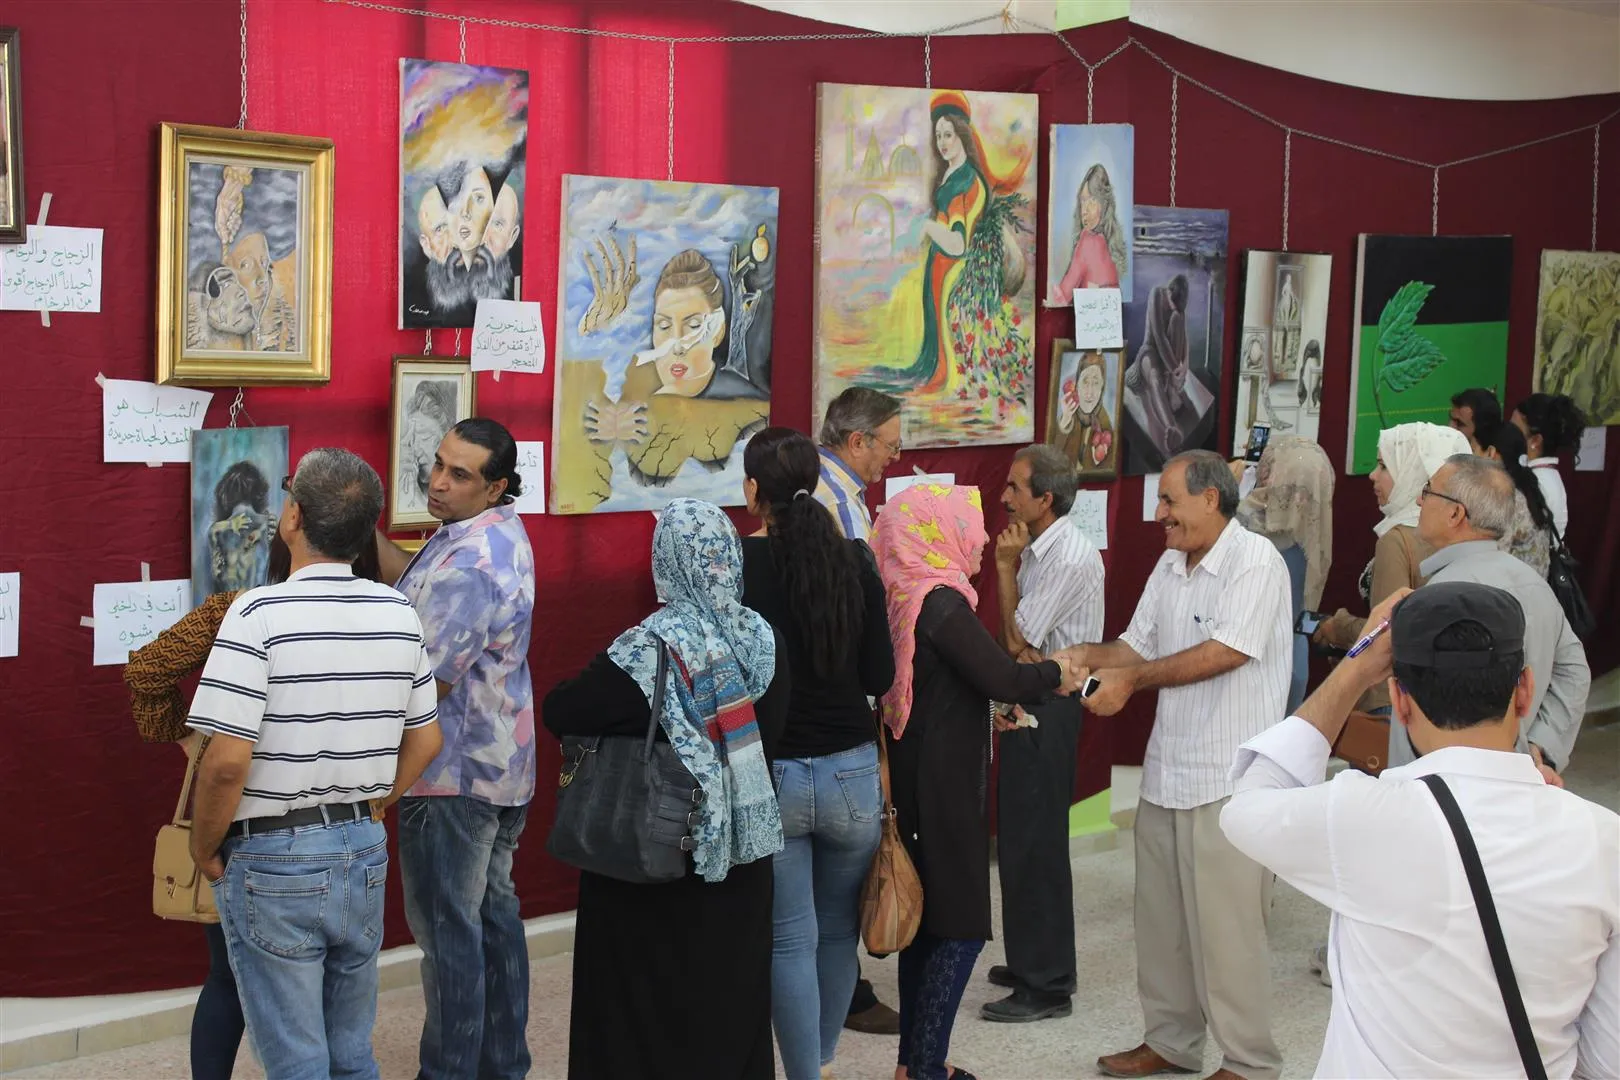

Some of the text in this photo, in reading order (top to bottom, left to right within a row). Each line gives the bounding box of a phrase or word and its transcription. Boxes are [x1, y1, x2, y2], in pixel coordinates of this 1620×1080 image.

[51, 242, 94, 267] الزجاج
[24, 272, 58, 296] الزجاج
[34, 295, 92, 310] من الرخام
[492, 338, 506, 352] من
[112, 396, 200, 423] الشباب هو
[108, 420, 136, 445] جديدة
[140, 594, 153, 619] في
[155, 586, 182, 613] أنت
